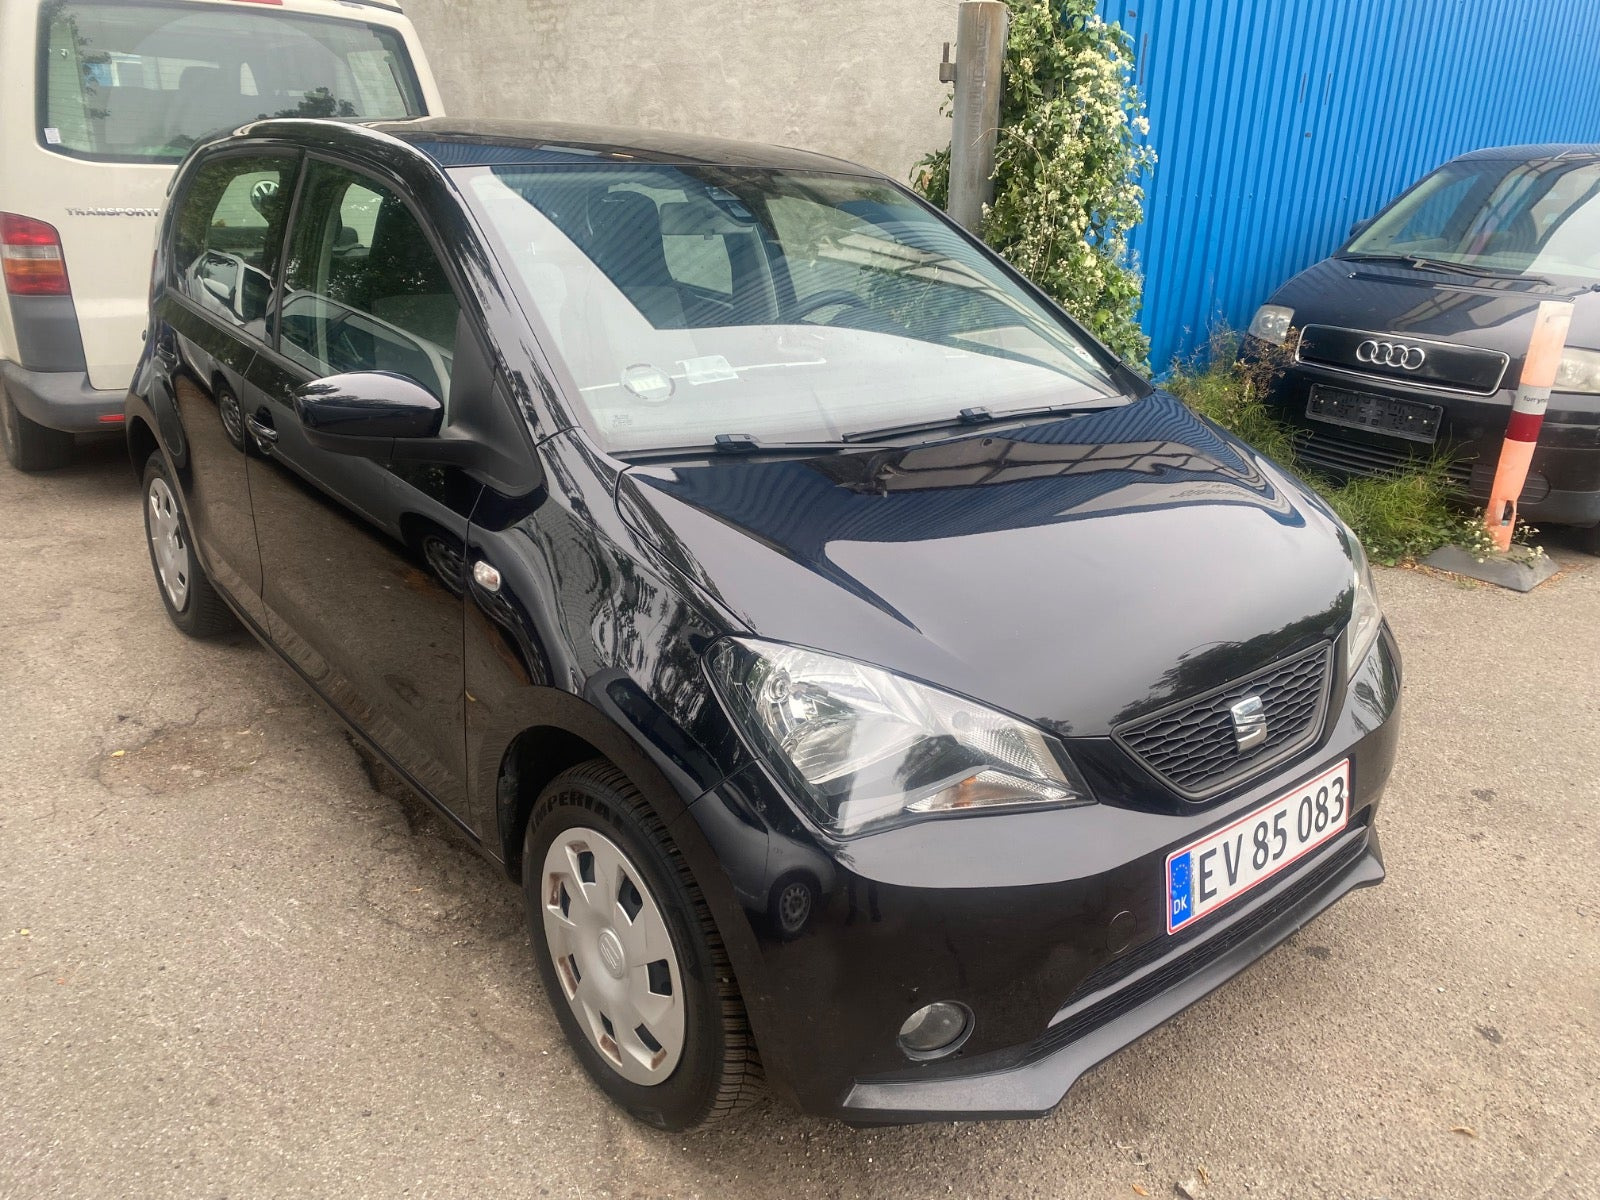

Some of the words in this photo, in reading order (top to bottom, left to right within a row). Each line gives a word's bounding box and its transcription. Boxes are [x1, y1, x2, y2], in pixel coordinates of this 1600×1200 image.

[1199, 833, 1243, 904] EV
[1252, 809, 1288, 871] 85
[1297, 776, 1345, 843] 083
[1173, 894, 1188, 915] DK
